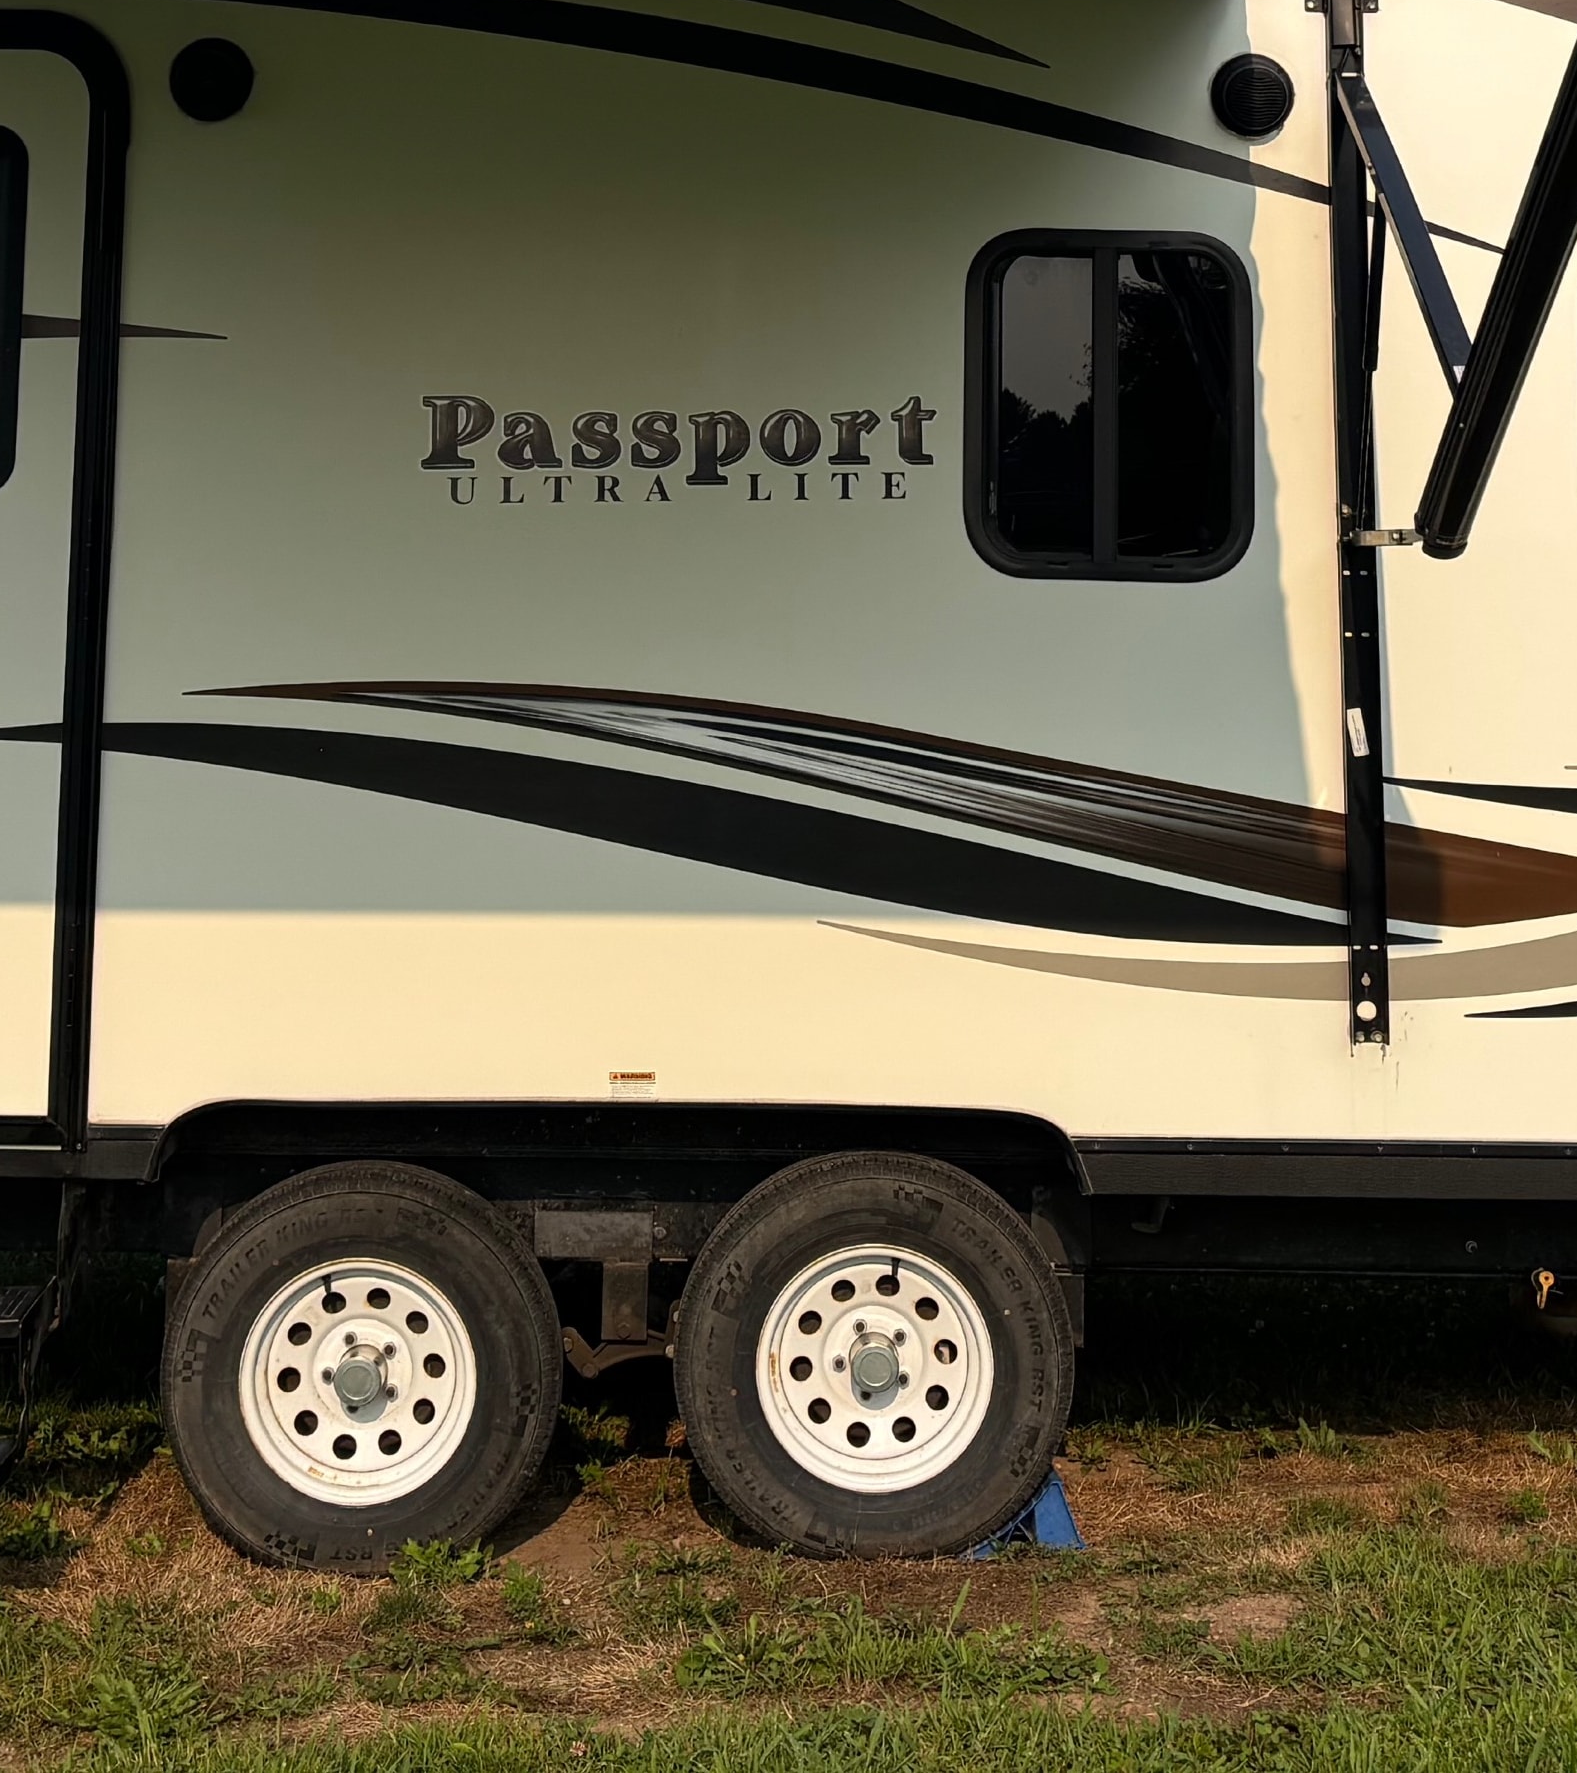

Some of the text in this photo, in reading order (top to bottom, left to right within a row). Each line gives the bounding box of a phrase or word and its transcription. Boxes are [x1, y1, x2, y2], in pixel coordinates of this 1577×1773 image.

[420, 395, 938, 486] Passport
[447, 472, 908, 505] ULTRA LITE
[951, 1217, 1045, 1413] TRAILER KING RST
